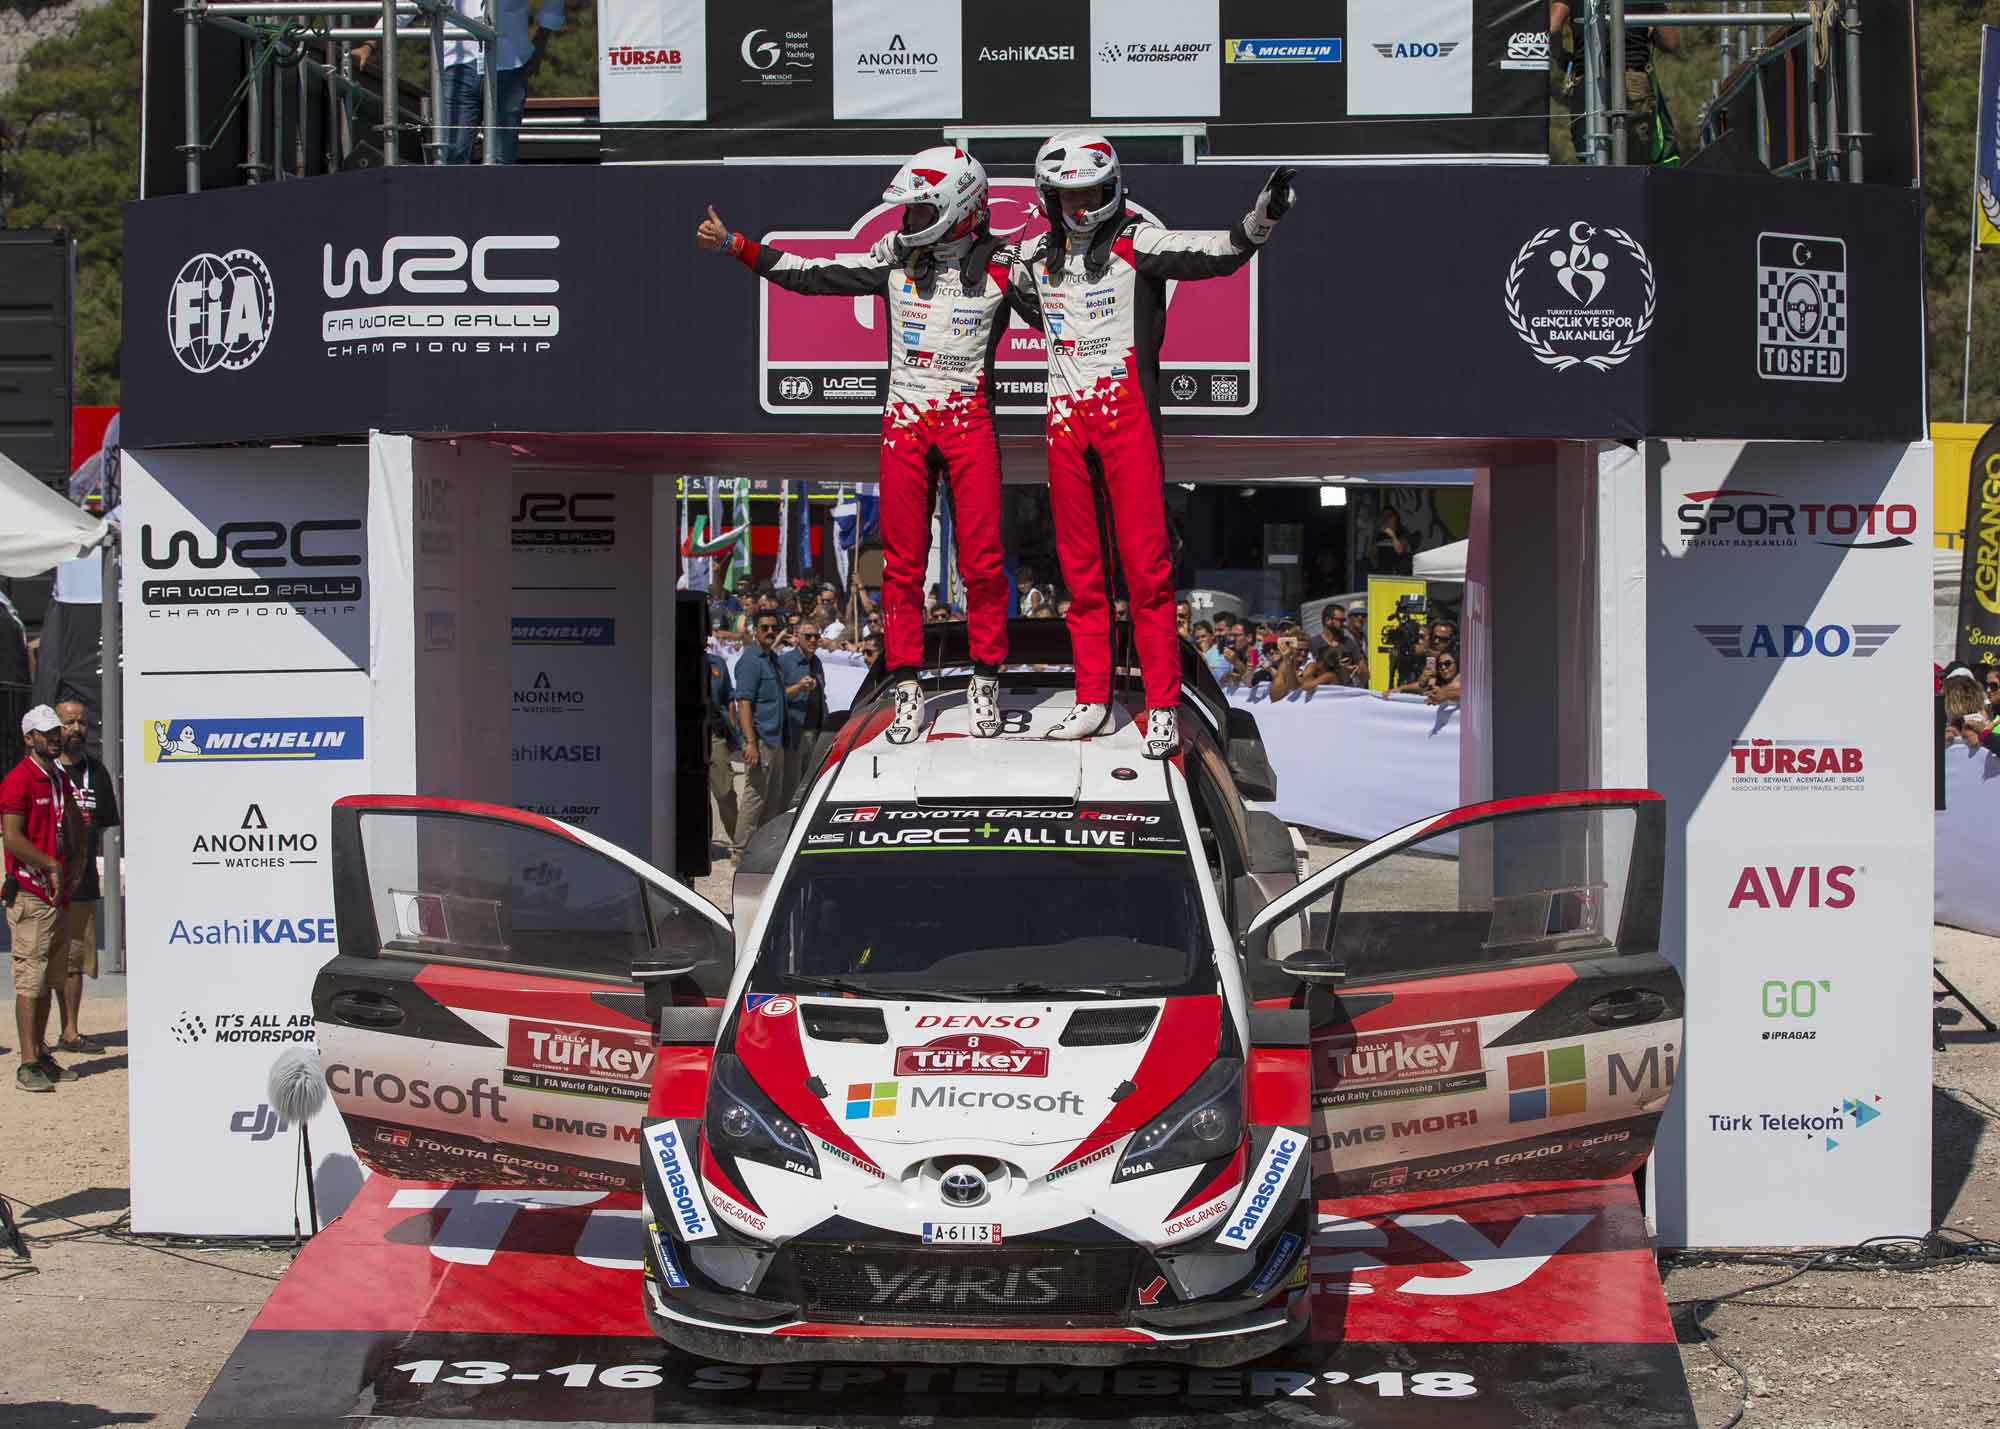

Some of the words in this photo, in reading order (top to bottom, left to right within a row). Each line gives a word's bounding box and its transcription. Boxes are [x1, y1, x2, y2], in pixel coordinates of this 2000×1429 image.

[785, 31, 808, 39] Global
[785, 42, 809, 50] Impact
[978, 46, 1075, 61] AsahiKASEI
[1150, 43, 1169, 53] ALL
[1174, 43, 1211, 53] ABOUT
[1258, 45, 1332, 57] MICHELIN
[1395, 42, 1439, 59] ADO
[608, 45, 682, 66] TÜRSAB
[786, 51, 816, 61] Yachting
[857, 53, 938, 66] ANONIMO
[1127, 52, 1199, 63] MOTORSPORT
[878, 68, 918, 76] WATCHES
[323, 235, 560, 299] WRC
[1087, 298, 1107, 309] Mobil
[328, 318, 353, 332] FIA
[359, 314, 444, 329] WORLD
[455, 313, 552, 328] RALLY
[902, 310, 928, 320] DENSO
[952, 317, 974, 325] Mobil
[1584, 316, 1600, 328] VE
[1601, 316, 1632, 328] SPOR
[1077, 343, 1108, 352] GAZOO
[1078, 336, 1111, 346] TOYOTA
[327, 342, 551, 357] CHAMPIONSHIP
[936, 353, 970, 361] TOYOTA
[1076, 349, 1107, 358] Racing
[933, 364, 965, 372] Racing
[1763, 347, 1841, 375] TOSFED
[141, 519, 362, 570] WRC
[148, 586, 182, 598] FIA
[188, 585, 270, 597] WORLD
[276, 583, 356, 596] RALLY
[149, 606, 356, 618] CHAMPIONSHIP
[1747, 624, 1850, 658] ADO
[205, 731, 346, 750] MICHELIN
[1731, 742, 1863, 774] TÜRSAB
[560, 805, 601, 815] ABOUT
[832, 812, 875, 822] GR
[885, 809, 980, 820] TOYOTA
[986, 808, 1074, 819] GAZOO
[1079, 810, 1161, 824] Racing
[192, 834, 318, 853] ANONIMO
[1003, 828, 1056, 844] ALL
[1065, 829, 1125, 846] LIVE
[225, 857, 285, 868] WATCHES
[1727, 865, 1857, 909] AVIS
[1761, 979, 1817, 1018] GO
[249, 1014, 281, 1027] ALL
[914, 1015, 1040, 1029] DENSO
[554, 1034, 587, 1044] RALLY
[967, 1036, 980, 1047] 8
[527, 1030, 656, 1080] Turkey
[1355, 1043, 1388, 1053] RALLY
[912, 1050, 1032, 1072] Turkey
[1607, 1043, 1675, 1097] Mi
[325, 1063, 509, 1123] crosoft
[544, 1078, 558, 1087] FIA
[560, 1080, 586, 1090] World
[587, 1082, 609, 1094] Rally
[910, 1086, 1085, 1115] Microsoft
[1321, 1093, 1345, 1104] World
[1348, 1089, 1370, 1101] Rally
[1373, 1085, 1434, 1098] Championship
[532, 1113, 608, 1138] DMG
[1708, 1113, 1752, 1131] Türk
[1760, 1113, 1844, 1131] Telekom
[1312, 1124, 1386, 1152] DMG
[1391, 1109, 1478, 1139] MORI
[377, 1131, 411, 1146] GR
[415, 1138, 488, 1161] TOYOTA
[492, 1153, 559, 1173] GAZOO
[562, 1164, 626, 1186] Racing
[821, 1140, 851, 1161] DMG
[851, 1158, 886, 1180] MORI
[1412, 1159, 1490, 1181] TOYOTA
[1494, 1145, 1563, 1166] GAZOO
[1567, 1129, 1631, 1153] Racing
[785, 1159, 814, 1177] PIAA
[1045, 1164, 1079, 1183] DMG
[1079, 1144, 1115, 1168] MORI
[1121, 1161, 1154, 1177] PIAA
[653, 1131, 704, 1235] Panasonic
[1225, 1138, 1297, 1242] Panasonic
[711, 1194, 766, 1231] KONECRANES
[1164, 1200, 1229, 1237] KONECRANES
[992, 1234, 1001, 1242] 18
[393, 1360, 664, 1389] 13-16
